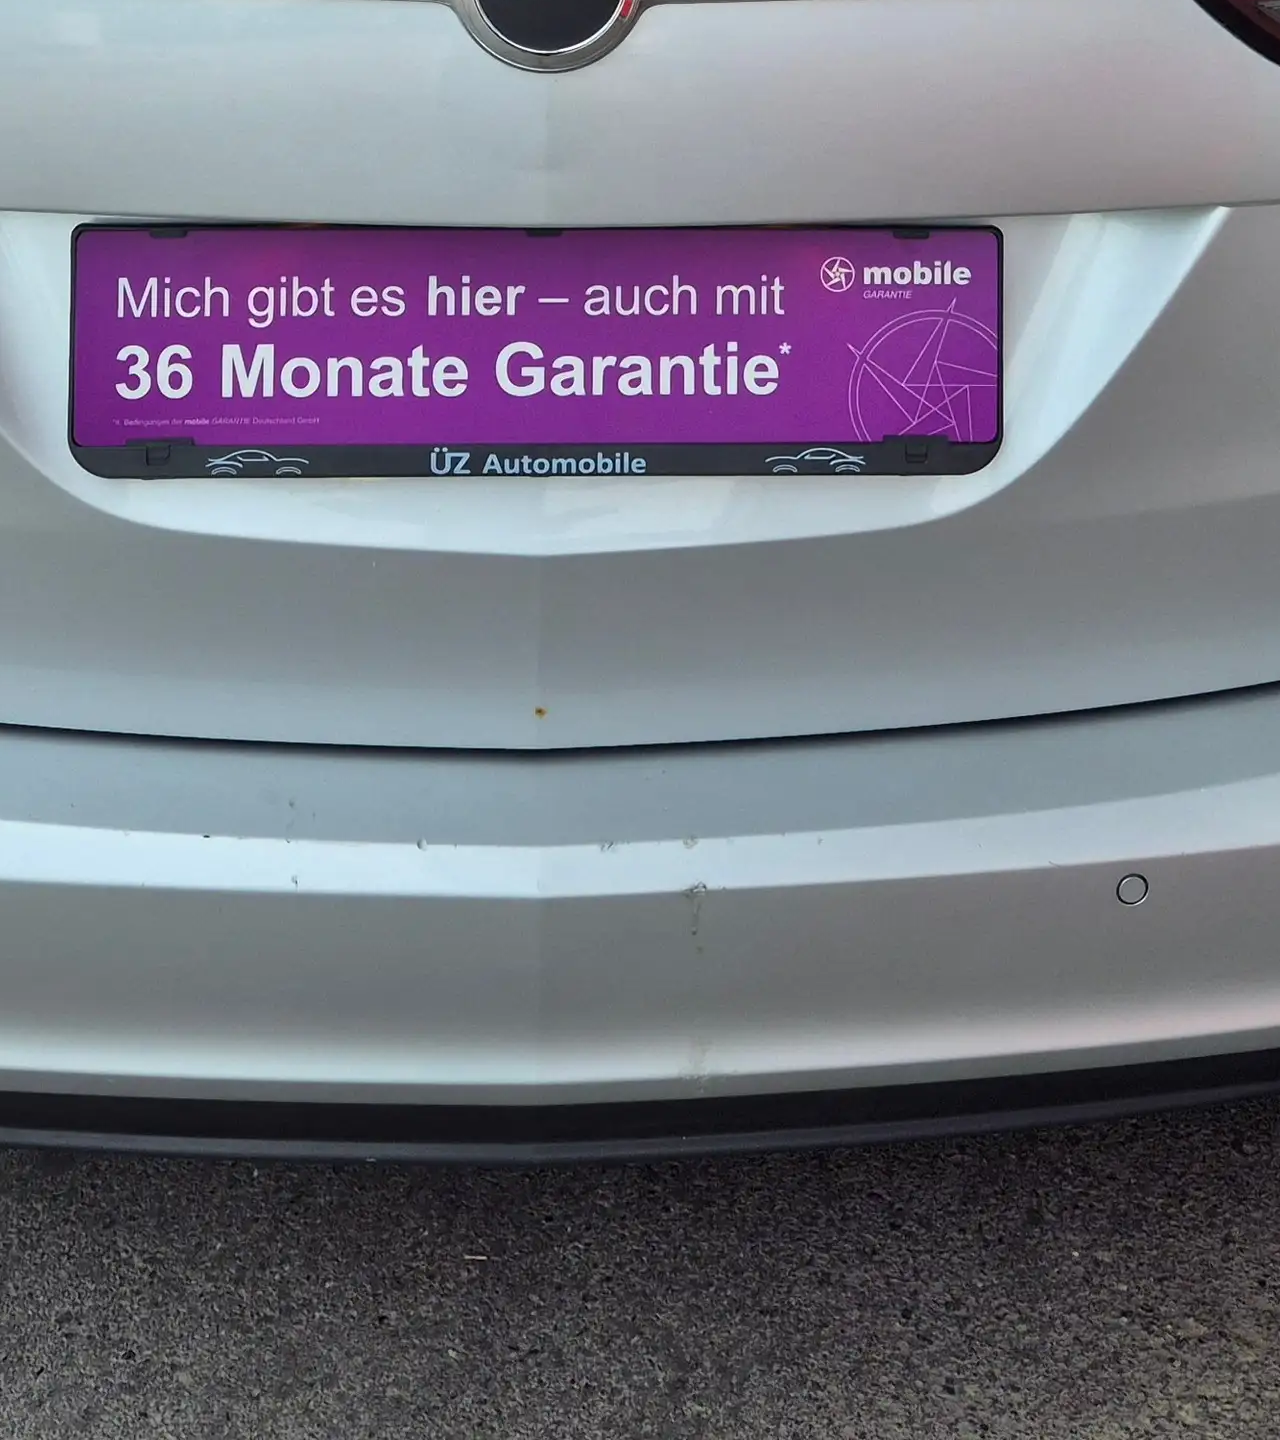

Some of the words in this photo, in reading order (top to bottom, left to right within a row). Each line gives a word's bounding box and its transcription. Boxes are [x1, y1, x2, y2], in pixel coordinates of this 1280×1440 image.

[863, 260, 972, 286] mobile
[116, 275, 230, 319] Mich
[247, 274, 336, 328] gibt
[350, 285, 406, 318] es
[428, 273, 526, 317] hier
[583, 273, 695, 317] auch
[716, 273, 786, 317] mit
[863, 290, 912, 299] GARANTIE
[115, 345, 194, 400] 36
[220, 344, 469, 399] Monate
[430, 448, 470, 475] ÜZ
[483, 450, 646, 476] Automobile
